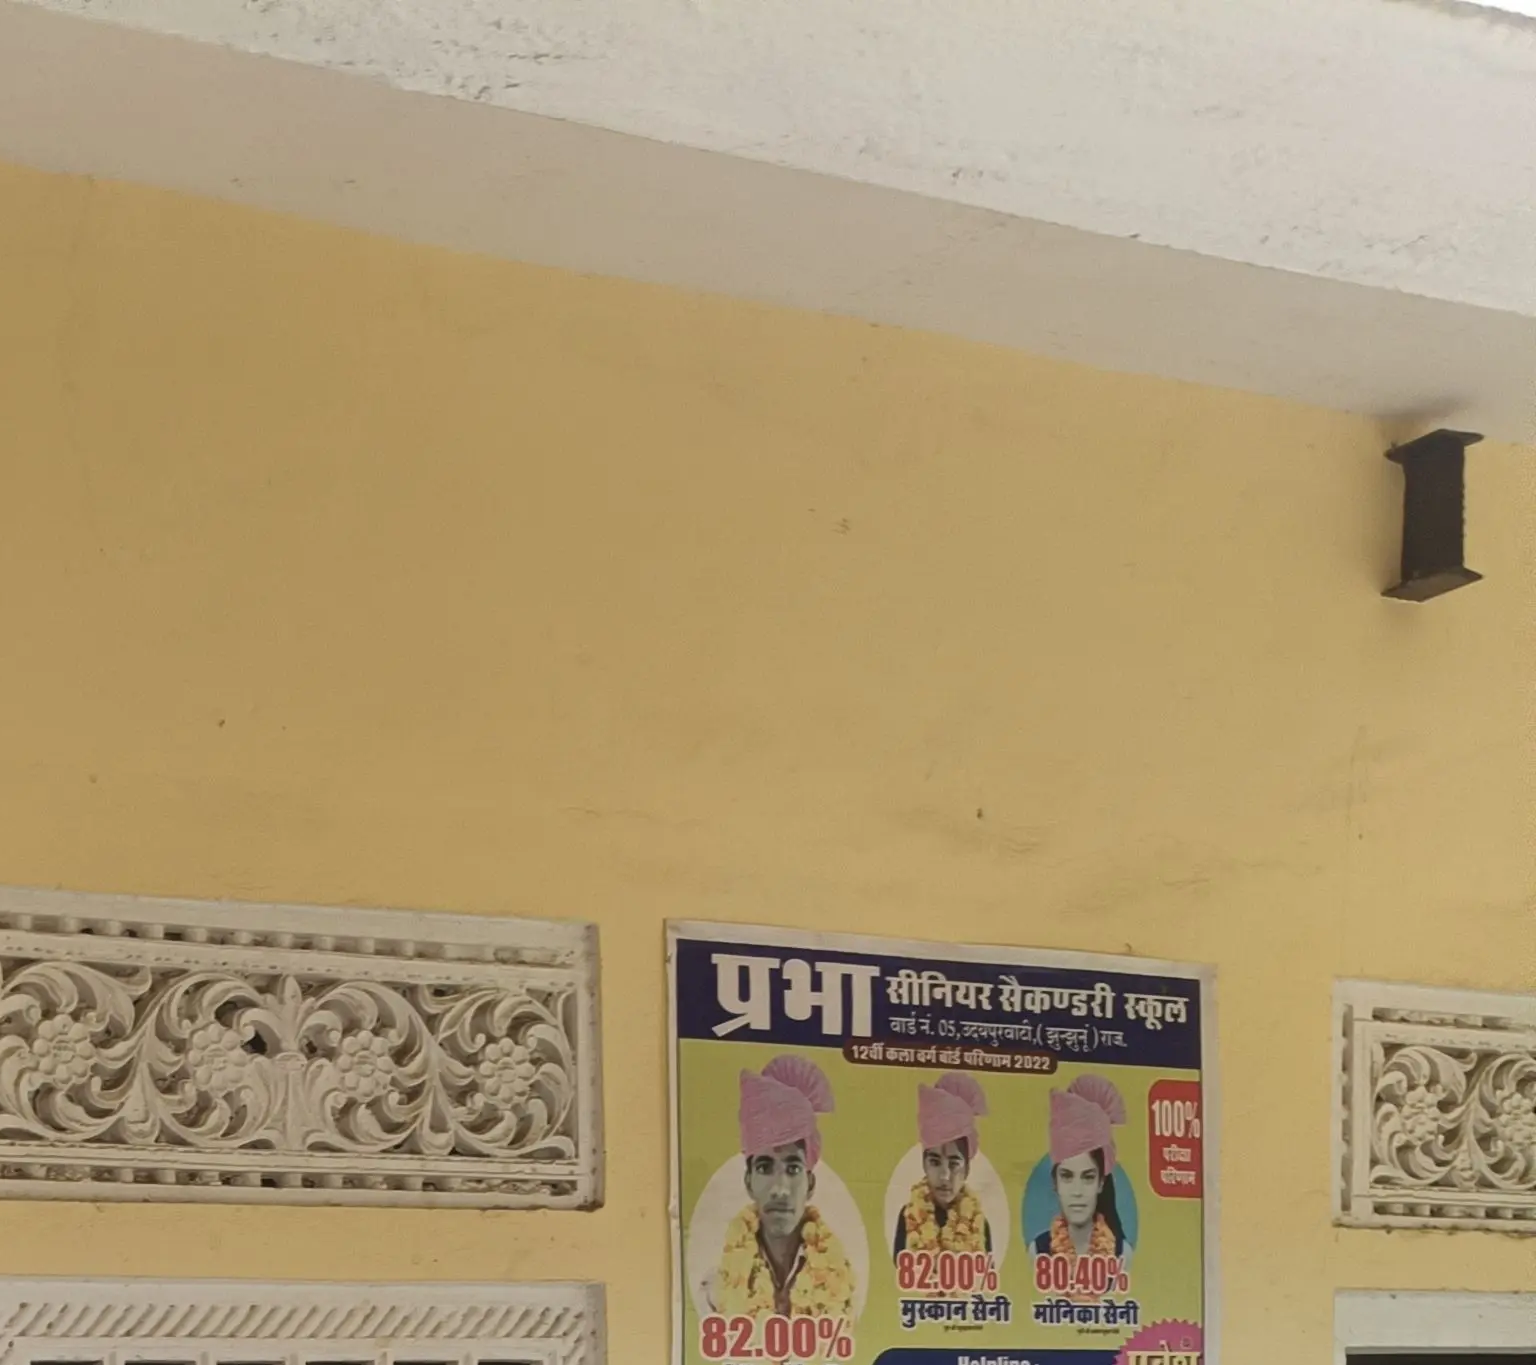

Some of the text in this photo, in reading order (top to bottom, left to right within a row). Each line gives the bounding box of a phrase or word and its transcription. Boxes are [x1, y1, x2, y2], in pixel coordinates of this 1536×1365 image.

[711, 953, 1189, 1038] प्रभा सीनियर सैकण्डरी स्कूल
[963, 1048, 1011, 1069] परिणाम
[1014, 1055, 1050, 1070] 2022
[1151, 1099, 1201, 1138] 100%
[897, 1251, 997, 1291] 82.00%
[1035, 1255, 1129, 1293] 80.40%
[901, 1295, 1010, 1329] मुस्कान सैनी
[1033, 1297, 1138, 1325] मोनिका सैनी
[702, 1317, 852, 1358] 82.00%
